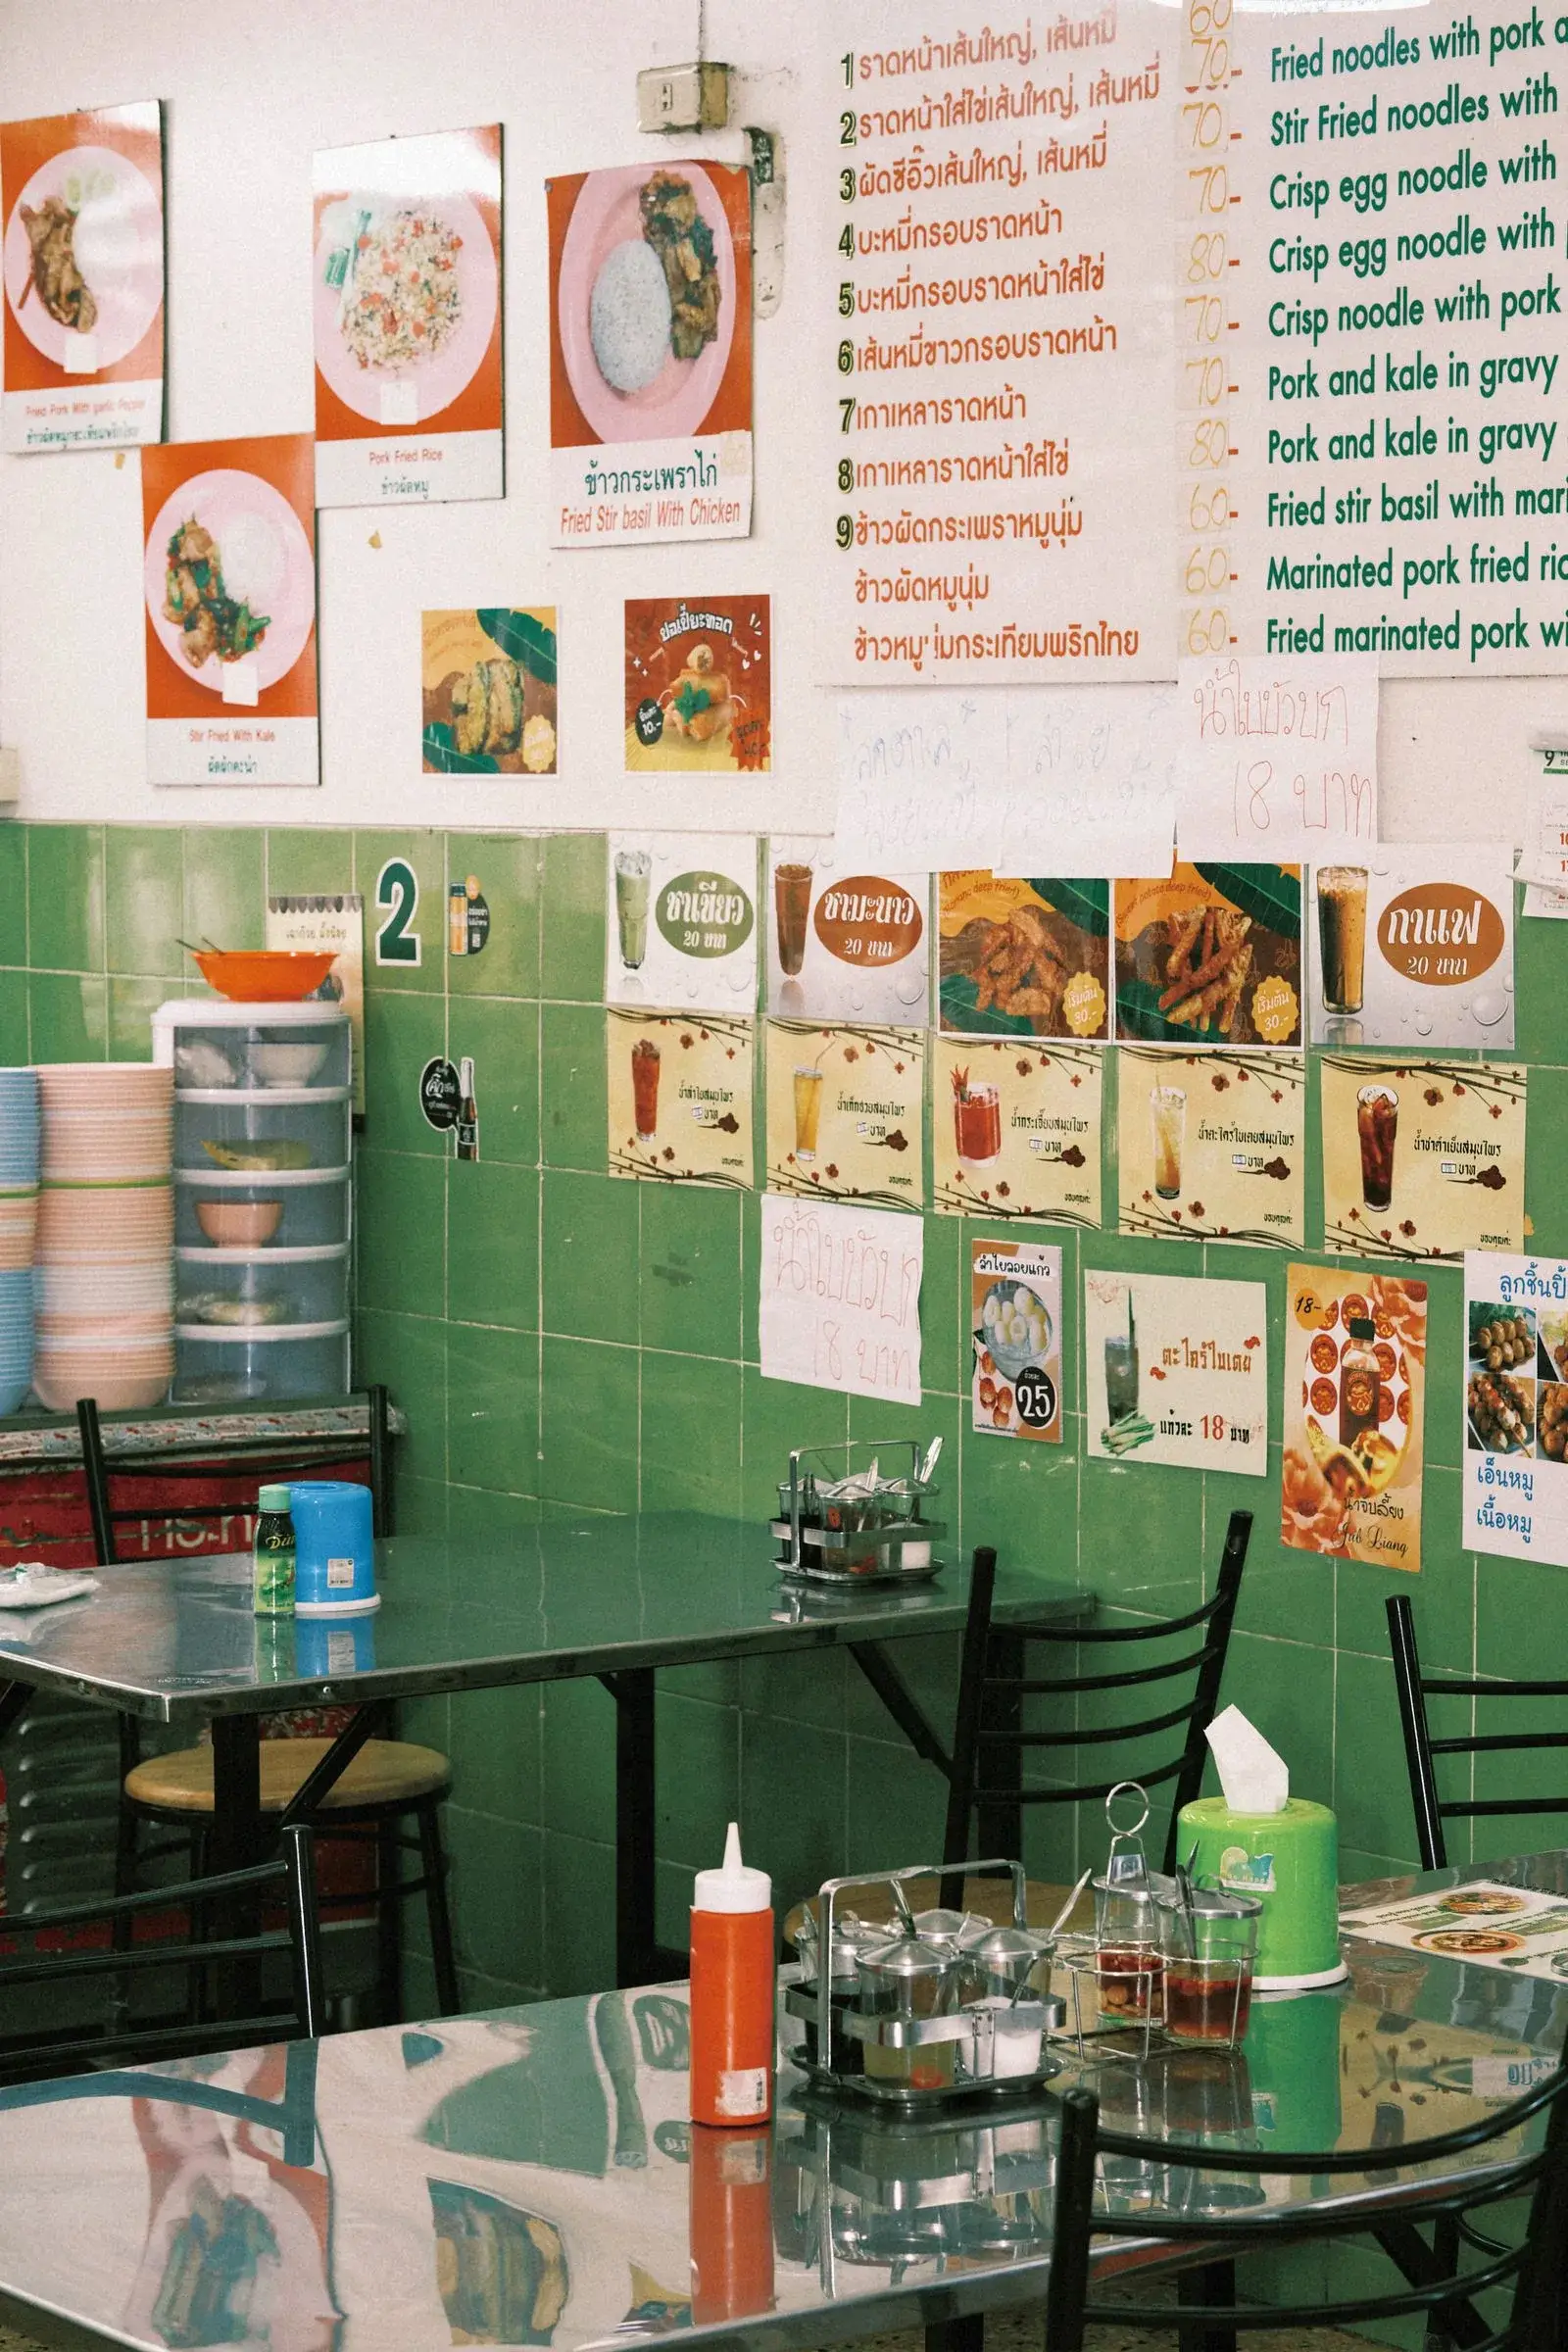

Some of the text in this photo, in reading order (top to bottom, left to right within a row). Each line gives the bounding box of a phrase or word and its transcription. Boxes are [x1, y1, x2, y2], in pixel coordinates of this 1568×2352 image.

[1272, 37, 1323, 82] Fried
[1333, 26, 1420, 74] noodles
[1430, 16, 1480, 60] with
[1491, 6, 1544, 66] pork
[841, 52, 854, 89] 1
[840, 110, 857, 147] 2
[1090, 51, 1160, 107] เส้นหมี่
[1271, 72, 1557, 146] Stir Fried noodles with
[840, 167, 856, 203] 3
[1038, 120, 1107, 174] เส้นหมี่
[1270, 139, 1556, 219] Crisp egg noodle with
[838, 199, 1062, 259] 4 บะหมี่กรอบราดหน้า
[1269, 207, 1554, 282] Crisp egg noodle with
[839, 252, 1104, 318] 5 บะหมี่กรอบราดหน้าใส่ไข่
[1268, 273, 1561, 347] Crisp noodle with pork
[838, 315, 1118, 375] 6 เส้นหมี่ขาวกรอบราดหน้า
[1269, 350, 1558, 400] Pork and kale in gravy
[839, 382, 1026, 434] 7 เกาเหลาราดหน้า
[368, 448, 443, 465] Pork Fried Rice
[838, 437, 1068, 493] 8 เกาเหลาราดหน้าใส่ไข่
[1269, 416, 1557, 465] Pork and kale in gravy
[585, 449, 717, 496] ข้าวกระเพราไก่
[561, 497, 740, 534] Fried Stir basil With Chicken
[836, 499, 1083, 551] 9 ข้าวผัดกระเพราหมูนุ่ม
[1268, 486, 1325, 527] Fried
[1335, 487, 1371, 524] stir
[1381, 479, 1439, 522] basil
[1449, 476, 1504, 518] with
[855, 564, 990, 612] ข้าวผัดหมูนุ่ม
[1267, 547, 1393, 590] Marinated
[1403, 544, 1460, 600] pork
[1470, 541, 1529, 583] fried
[1267, 612, 1324, 654] Fried
[1335, 610, 1460, 652] marinated
[1471, 608, 1529, 663] pork
[1234, 760, 1272, 836] 18
[376, 858, 421, 966] 2
[666, 881, 744, 925] ชาเขียว
[824, 892, 915, 926] ชามะนาว
[1388, 900, 1482, 946] กาแฟ
[683, 930, 727, 950] 20 บาท
[845, 937, 894, 957] 20 บาท
[1406, 956, 1467, 975] 20 บาท
[979, 1254, 1052, 1278] ลำไยลอยแก้ว
[1162, 1337, 1251, 1373] ตะไคร้ใบเตย
[1017, 1385, 1051, 1417] 25
[1160, 1409, 1250, 1444] แก้วละ 18 บาท
[1477, 1454, 1534, 1499] เอ็นหมู
[1366, 1525, 1408, 1558] Liang
[1477, 1496, 1532, 1544] เนื้อหมู
